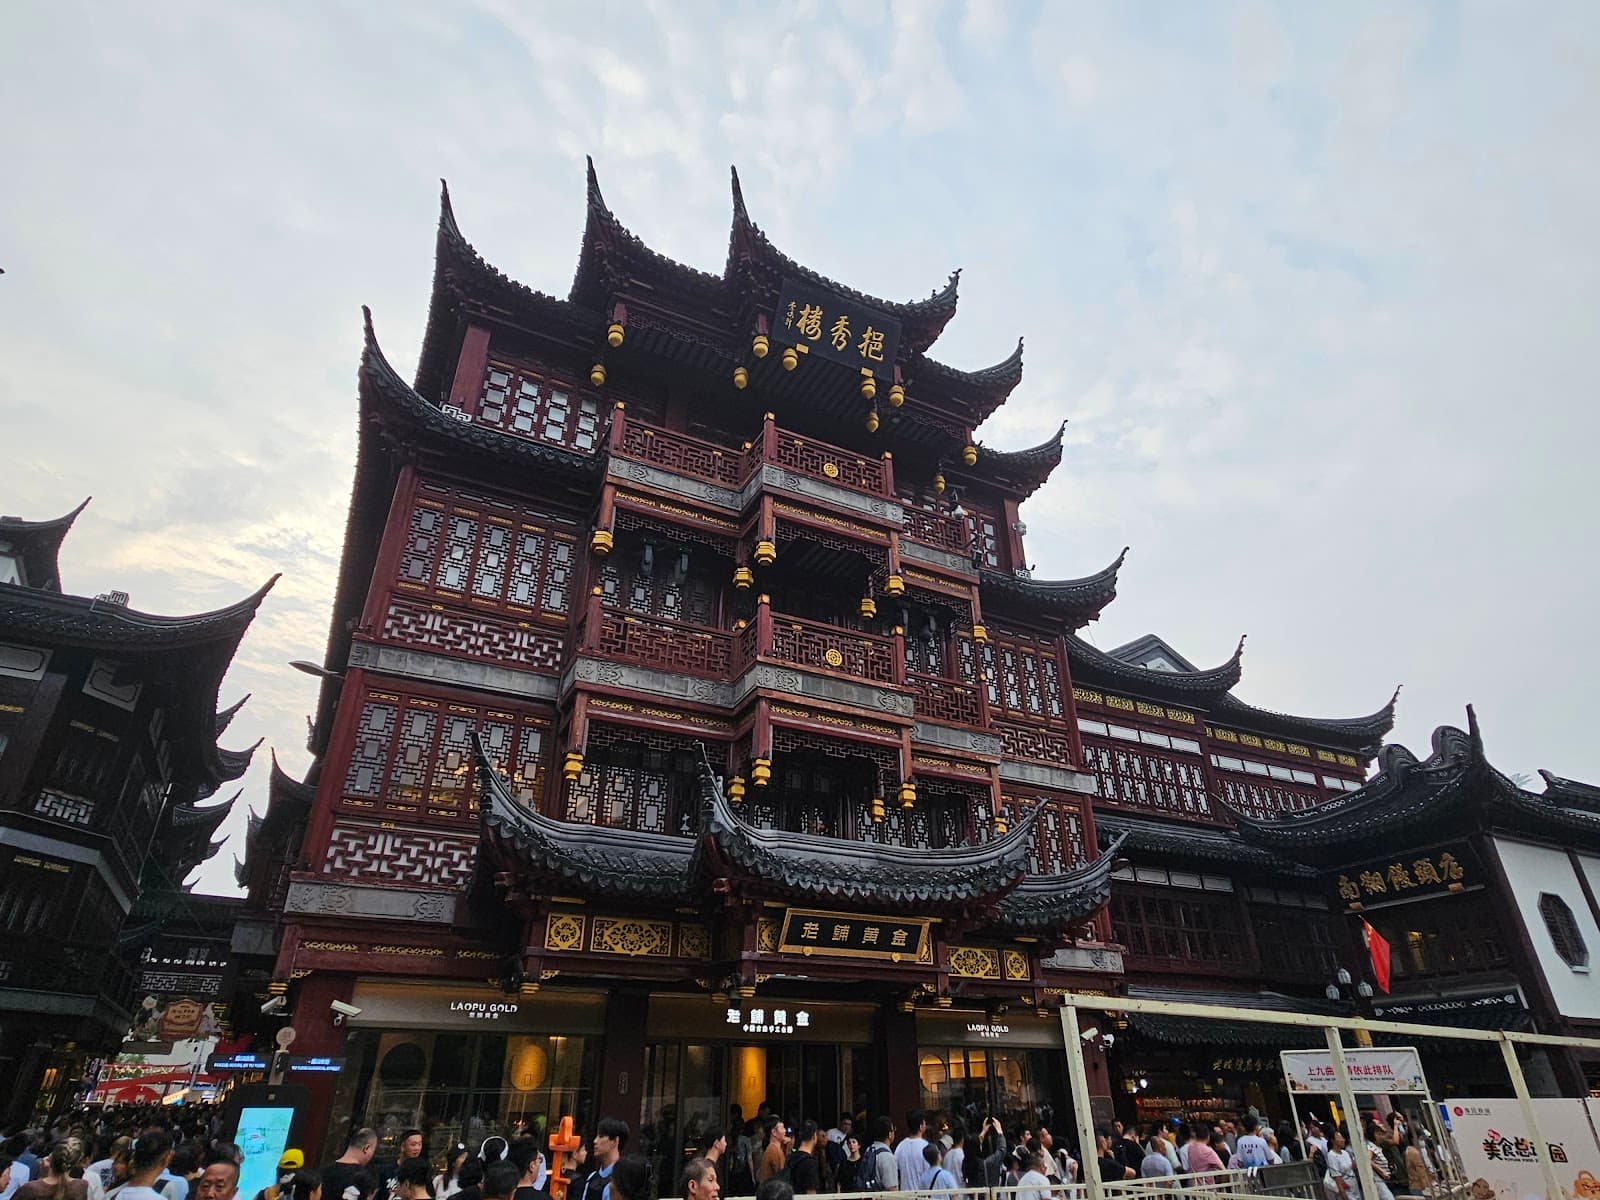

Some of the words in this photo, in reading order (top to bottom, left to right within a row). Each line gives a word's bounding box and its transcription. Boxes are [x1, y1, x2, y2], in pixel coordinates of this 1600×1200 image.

[450, 1002, 486, 1012] LAOPU
[489, 1003, 518, 1013] GOLD
[967, 1024, 990, 1032] LAOPU
